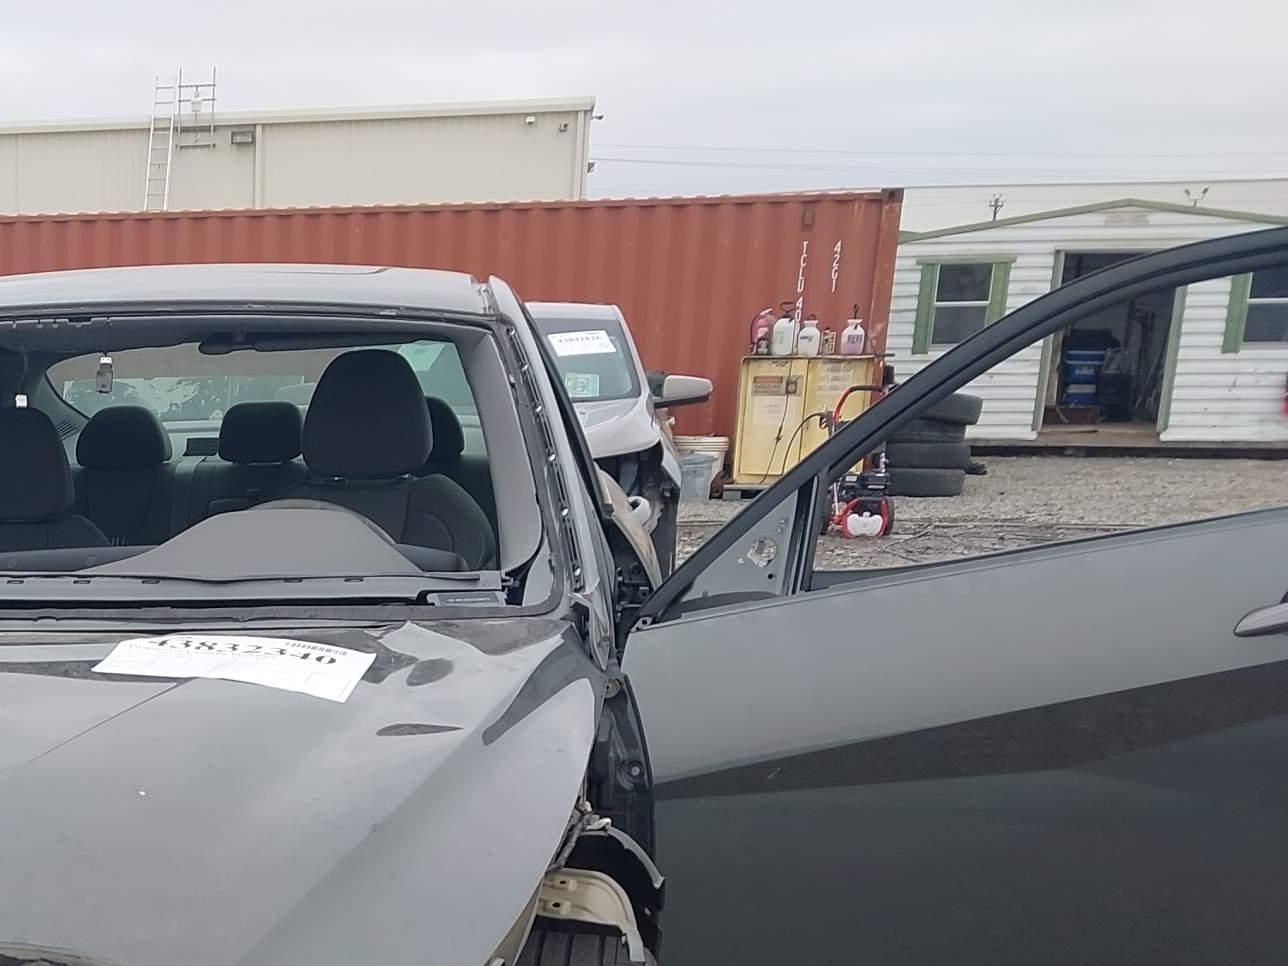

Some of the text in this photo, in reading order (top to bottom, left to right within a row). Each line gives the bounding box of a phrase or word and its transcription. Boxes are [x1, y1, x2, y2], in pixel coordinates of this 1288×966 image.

[797, 241, 808, 293] TCLU
[832, 240, 842, 293] 42G1
[148, 637, 337, 665] 43832340
